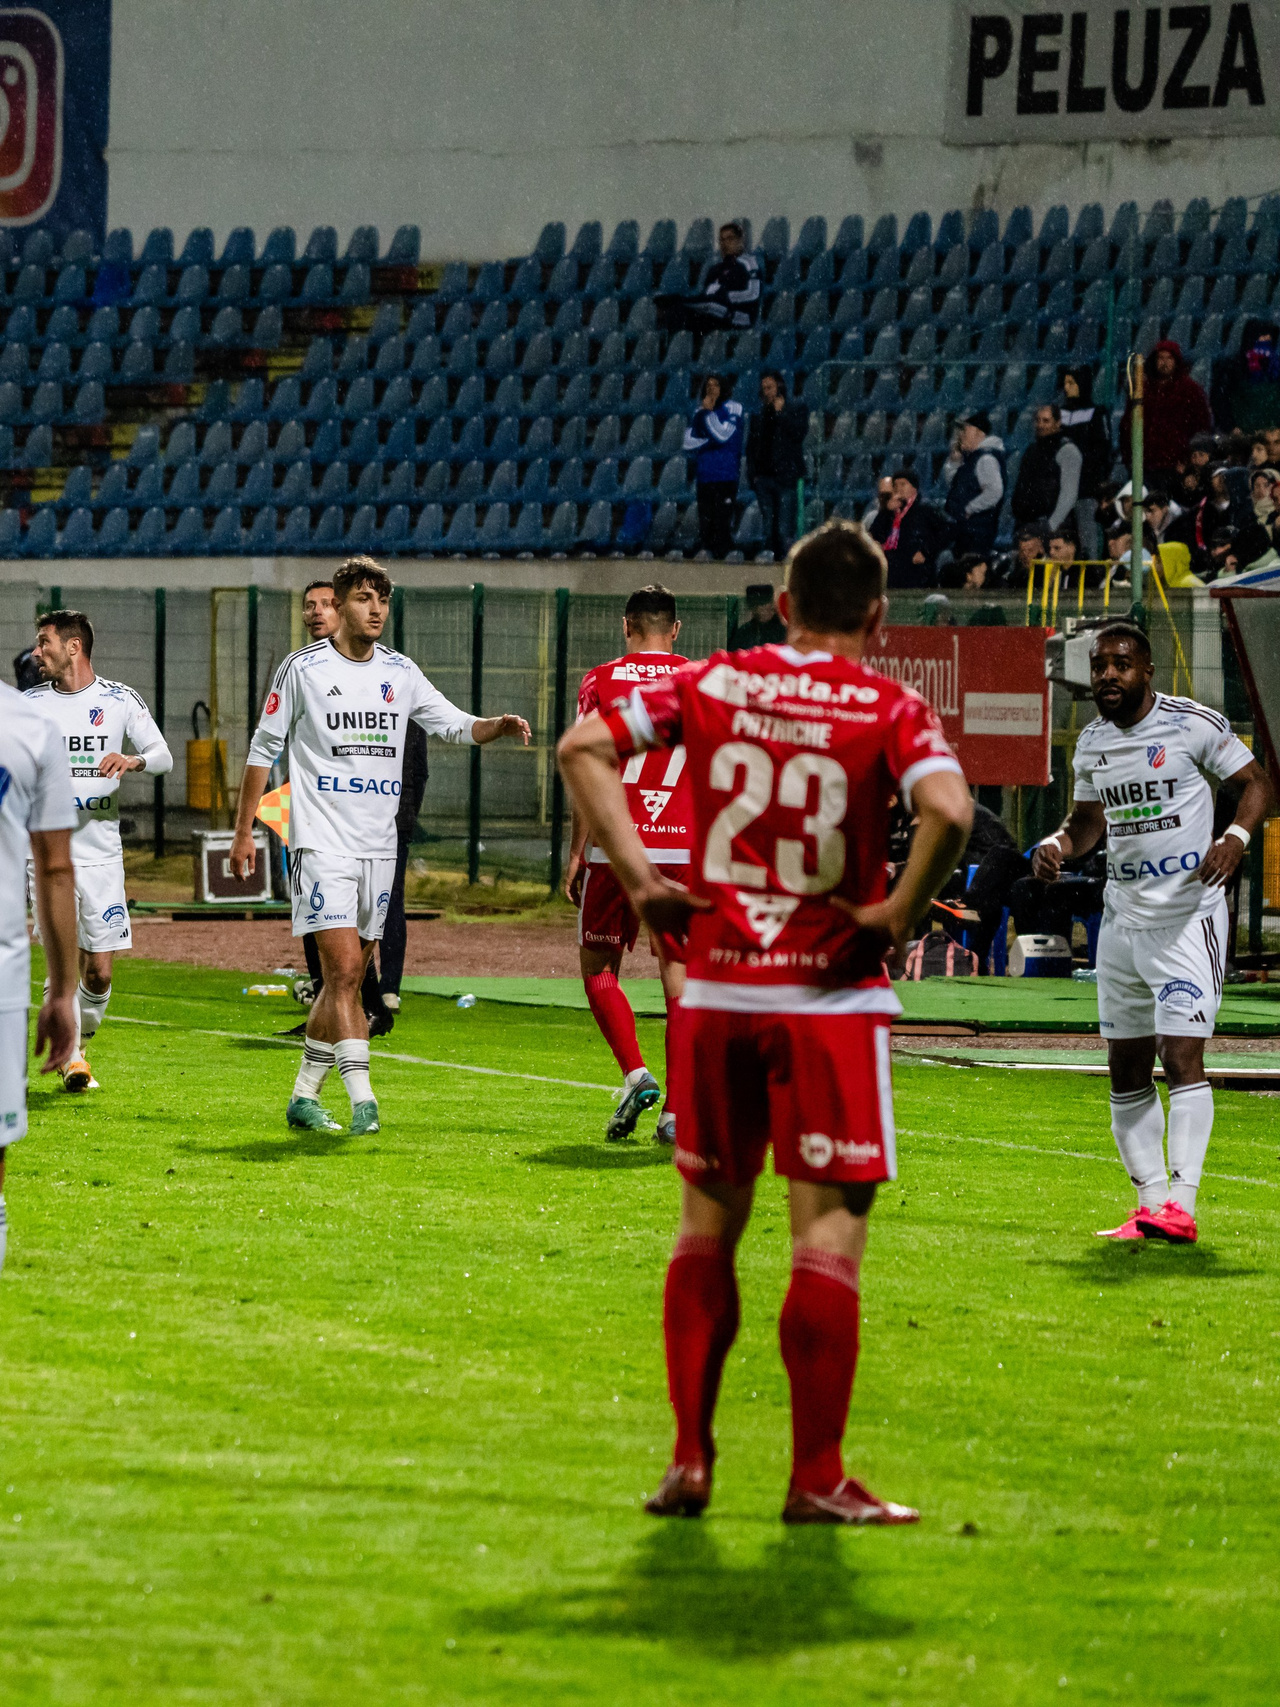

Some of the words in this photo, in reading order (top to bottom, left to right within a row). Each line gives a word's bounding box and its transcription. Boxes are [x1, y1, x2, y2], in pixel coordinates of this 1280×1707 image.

[966, 3, 1266, 116] PELUZA
[326, 711, 399, 731] UNIBET
[371, 747, 385, 756] SPRE
[385, 748, 394, 757] 0%
[317, 775, 402, 797] ELSACO
[1097, 778, 1179, 809] UNIBET
[642, 824, 687, 833] GAMING
[703, 741, 848, 896] 23
[1139, 820, 1160, 833] SPRE
[1161, 818, 1176, 829] 0%
[310, 881, 325, 912] 6
[746, 951, 829, 970] GAMING
